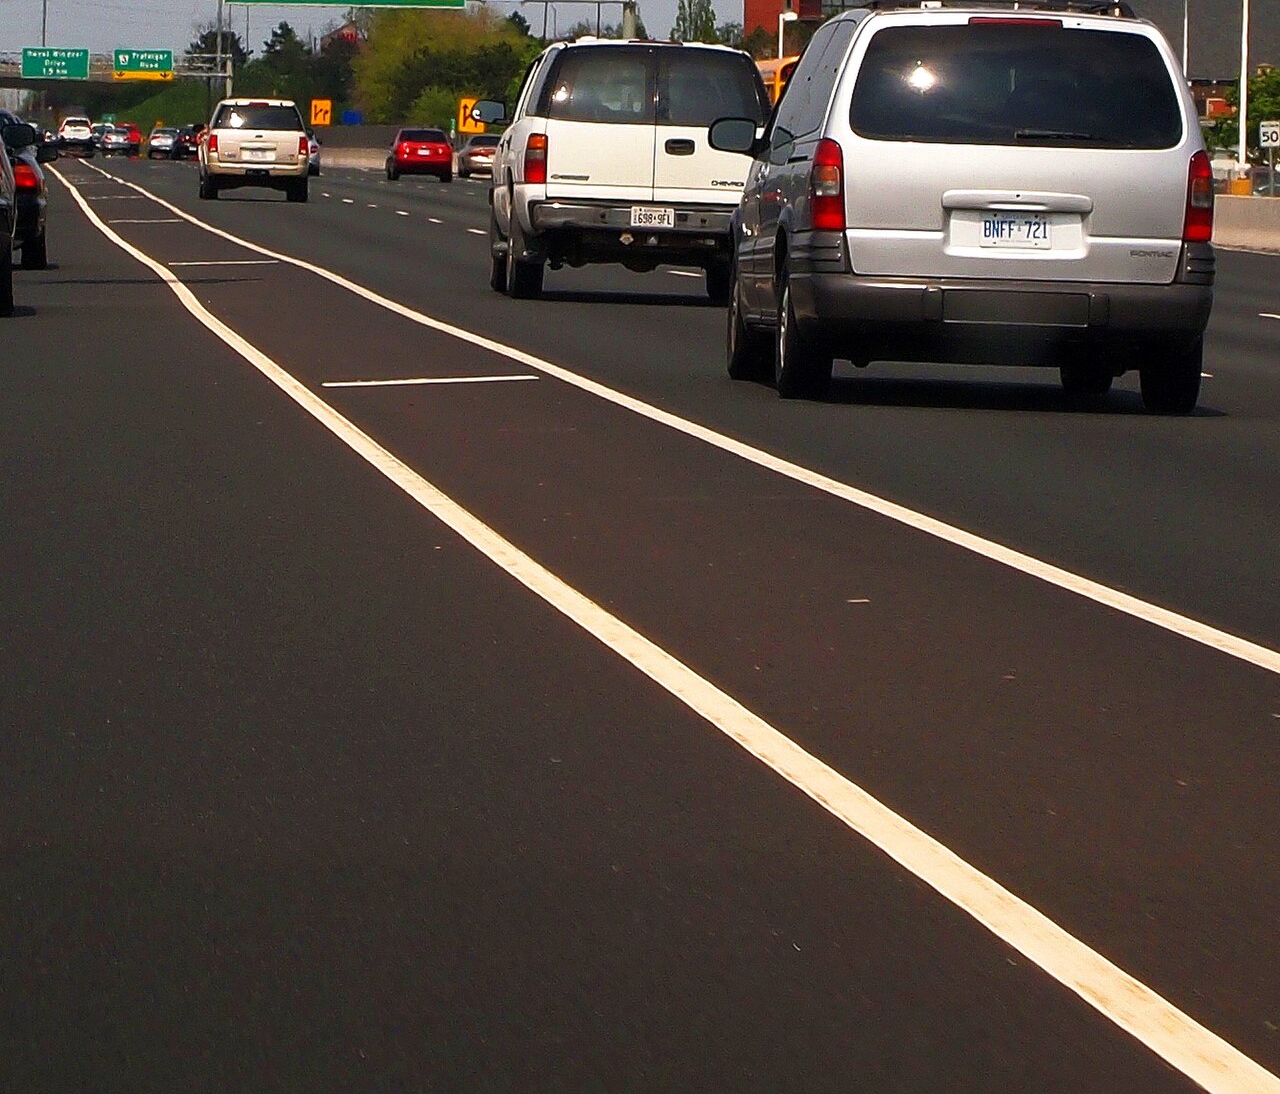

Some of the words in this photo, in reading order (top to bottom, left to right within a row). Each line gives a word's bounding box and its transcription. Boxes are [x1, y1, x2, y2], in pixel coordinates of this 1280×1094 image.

[1262, 130, 1279, 143] 50
[983, 219, 1016, 239] BNFF
[1024, 221, 1048, 240] 721
